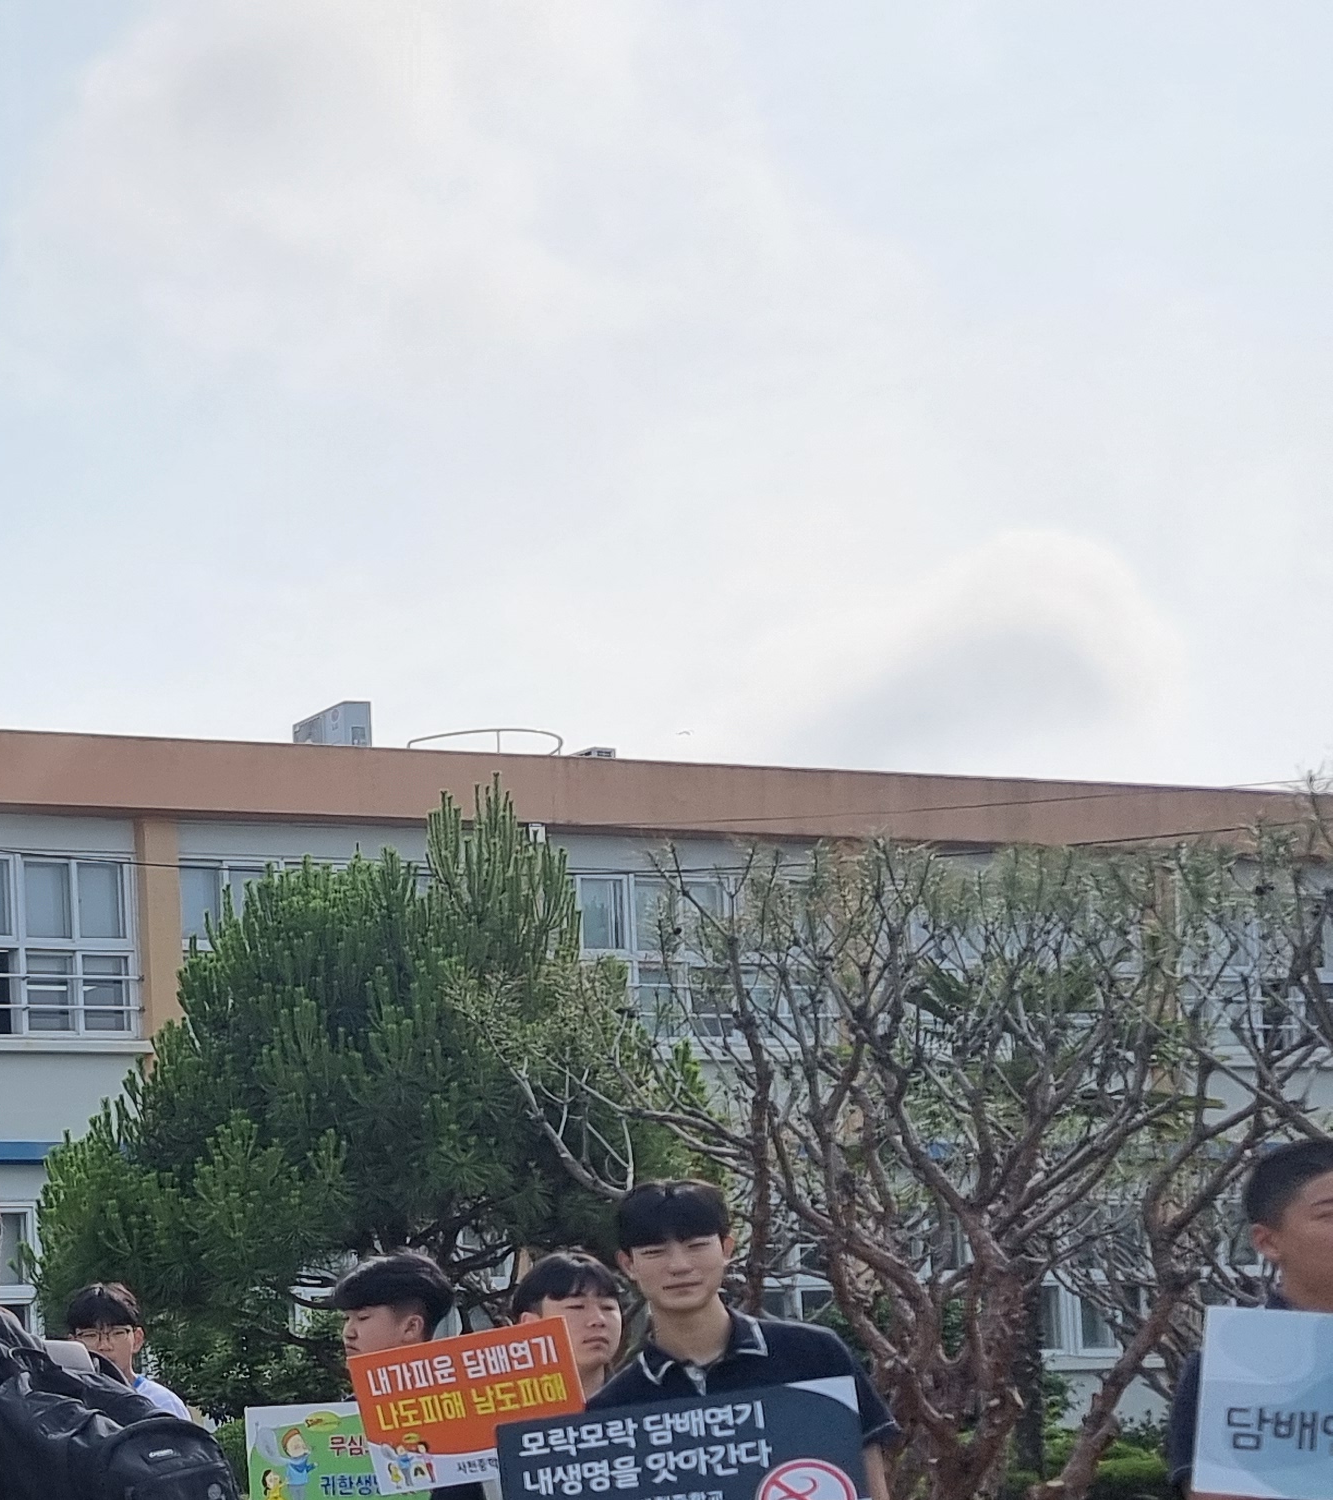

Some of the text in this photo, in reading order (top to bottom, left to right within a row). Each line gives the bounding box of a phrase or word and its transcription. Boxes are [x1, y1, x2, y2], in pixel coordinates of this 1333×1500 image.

[366, 1335, 559, 1397] 내가피운 담배연기
[375, 1371, 568, 1431] 나도피해 남도피해
[519, 1400, 766, 1457] 모락모락 담배연기
[1227, 1407, 1333, 1451] 담배
[329, 1435, 370, 1457] 무심
[456, 1457, 499, 1475] 사천중학
[523, 1439, 773, 1497] 내생명을 앗아간다
